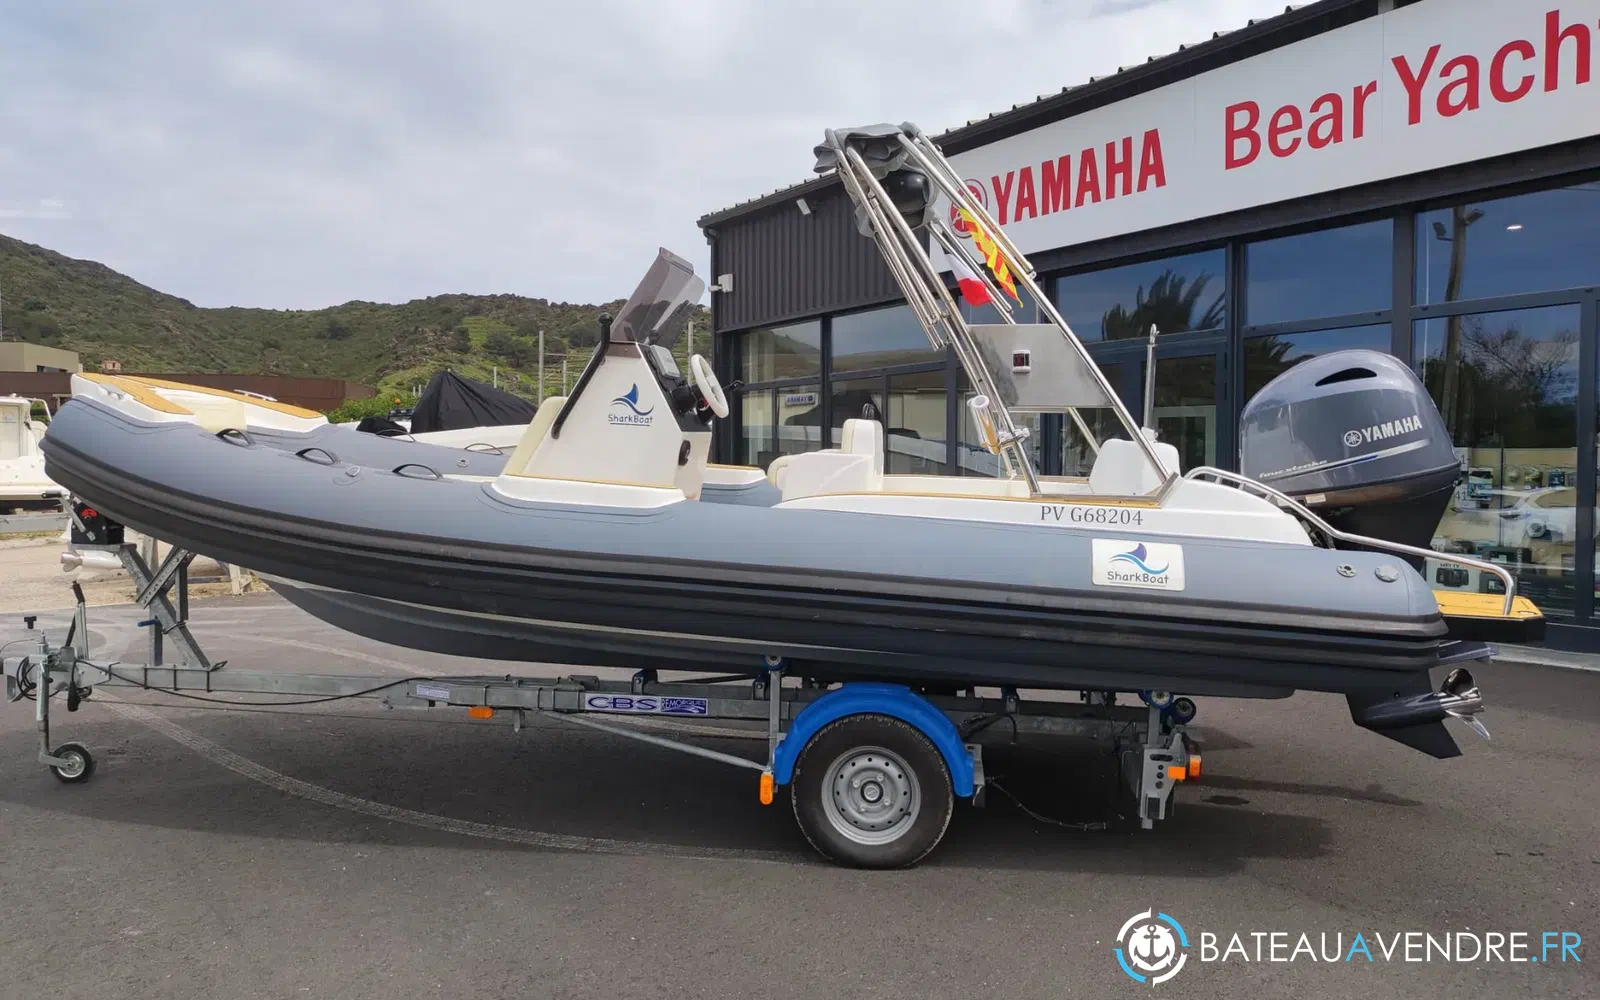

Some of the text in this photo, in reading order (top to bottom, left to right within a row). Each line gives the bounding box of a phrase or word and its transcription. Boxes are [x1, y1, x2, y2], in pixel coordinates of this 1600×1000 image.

[1225, 9, 1600, 170] Bear Yach
[992, 128, 1167, 226] YAMAHA
[608, 414, 653, 424] SharkBoat
[1361, 414, 1423, 443] YAMAHA
[1041, 505, 1143, 525] PV G68204
[1107, 571, 1169, 584] SharkBoat
